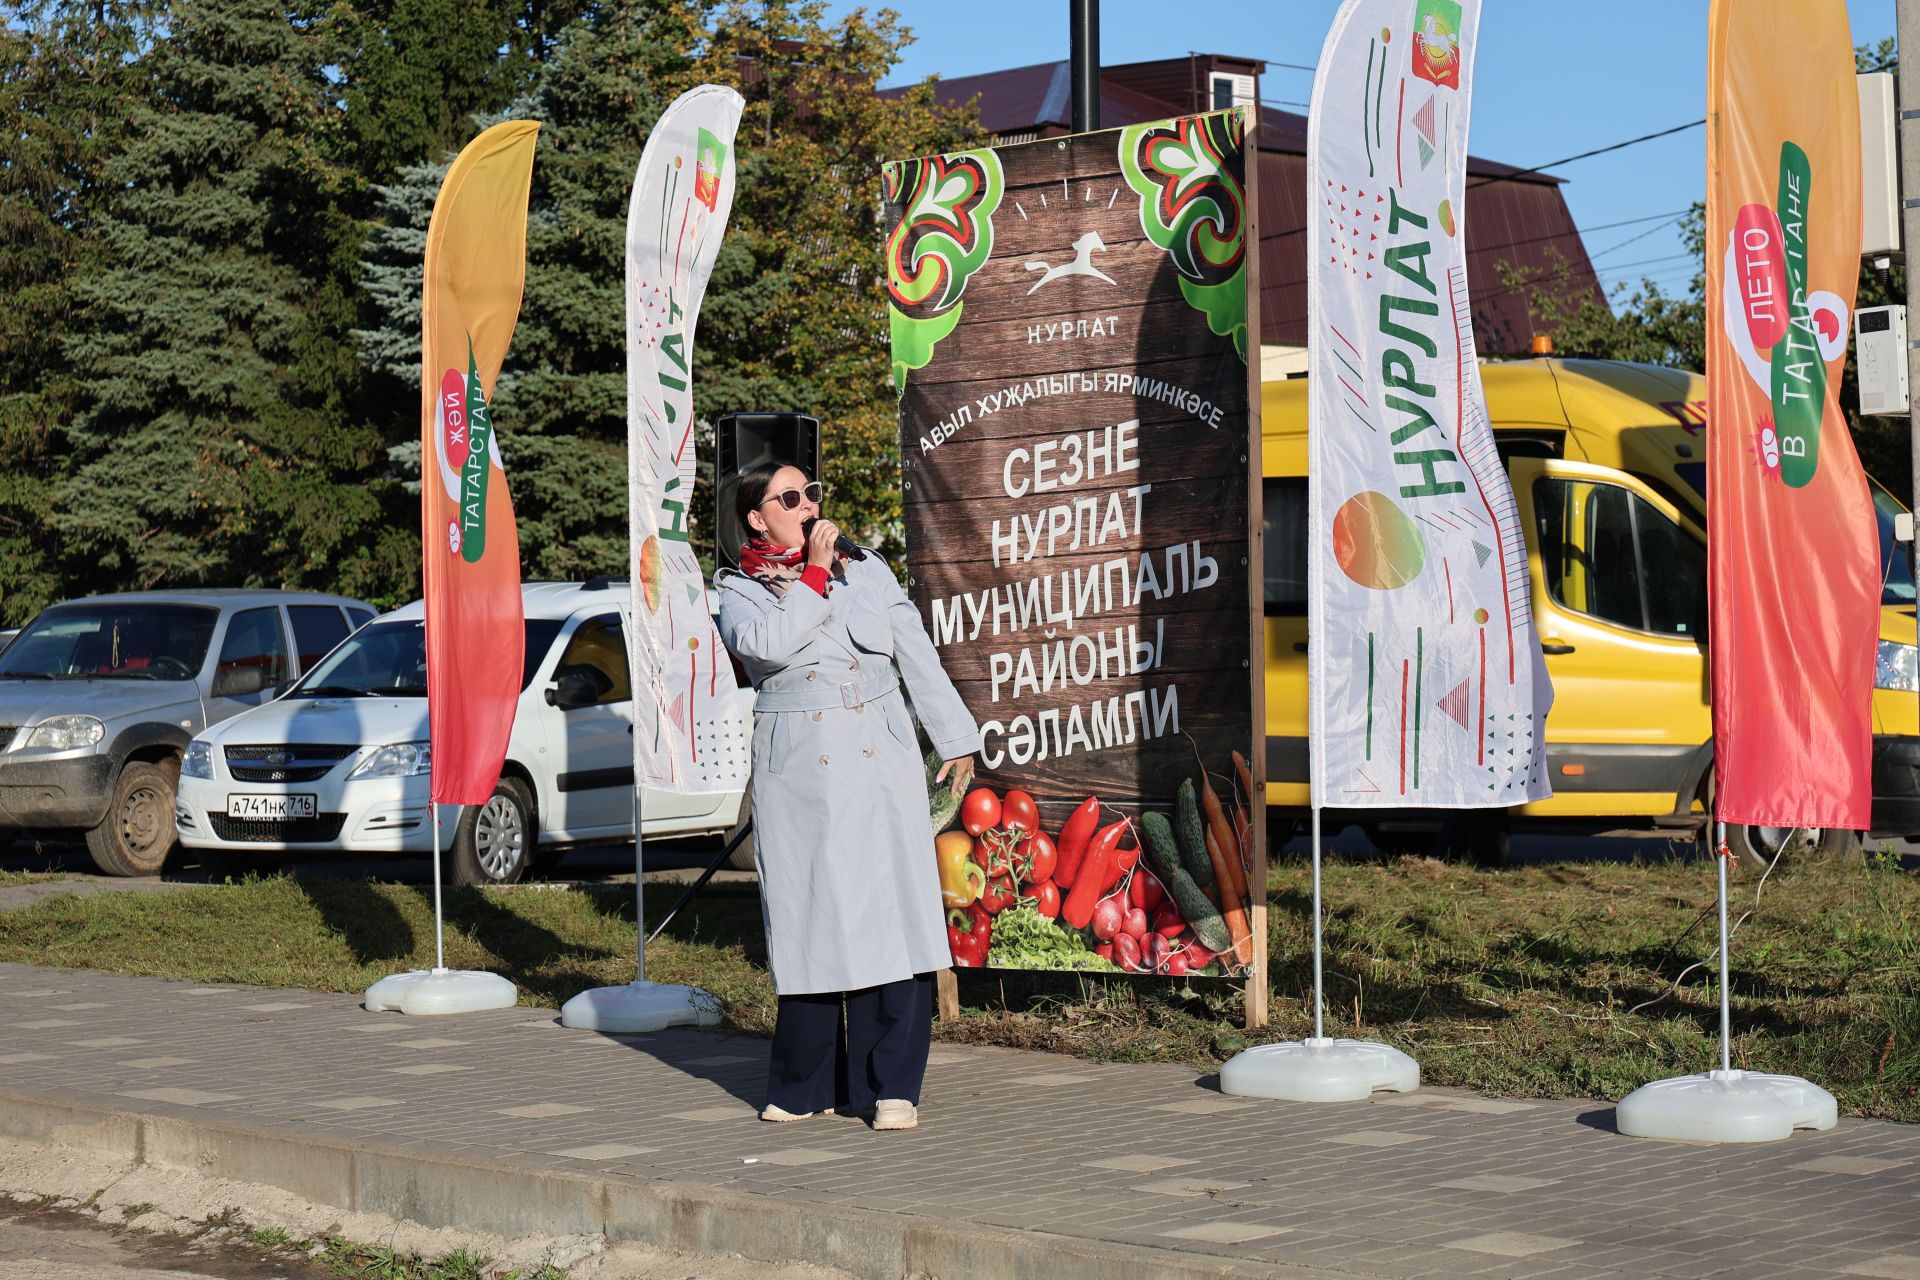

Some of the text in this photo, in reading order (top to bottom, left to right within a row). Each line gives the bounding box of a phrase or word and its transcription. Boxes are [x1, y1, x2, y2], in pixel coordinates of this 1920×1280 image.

[1743, 227, 1776, 323] ЛЕТО
[1027, 316, 1119, 344] НУРЛАТ
[1379, 186, 1466, 499] НУРЛАТ
[918, 372, 1225, 456] АВЫЛ ХУҖАЛЫГЫ ЯРМИНКӘСЕ
[1782, 435, 1806, 458] В
[1003, 419, 1141, 499] СЕЗНЕ
[991, 483, 1151, 568] НУРЛАТ
[931, 540, 1219, 647] МУНИЦИПАЛЬ
[990, 618, 1164, 702] РАЙОНЫ
[979, 684, 1180, 770] СӘЛАМЛИ
[289, 797, 311, 810] 716
